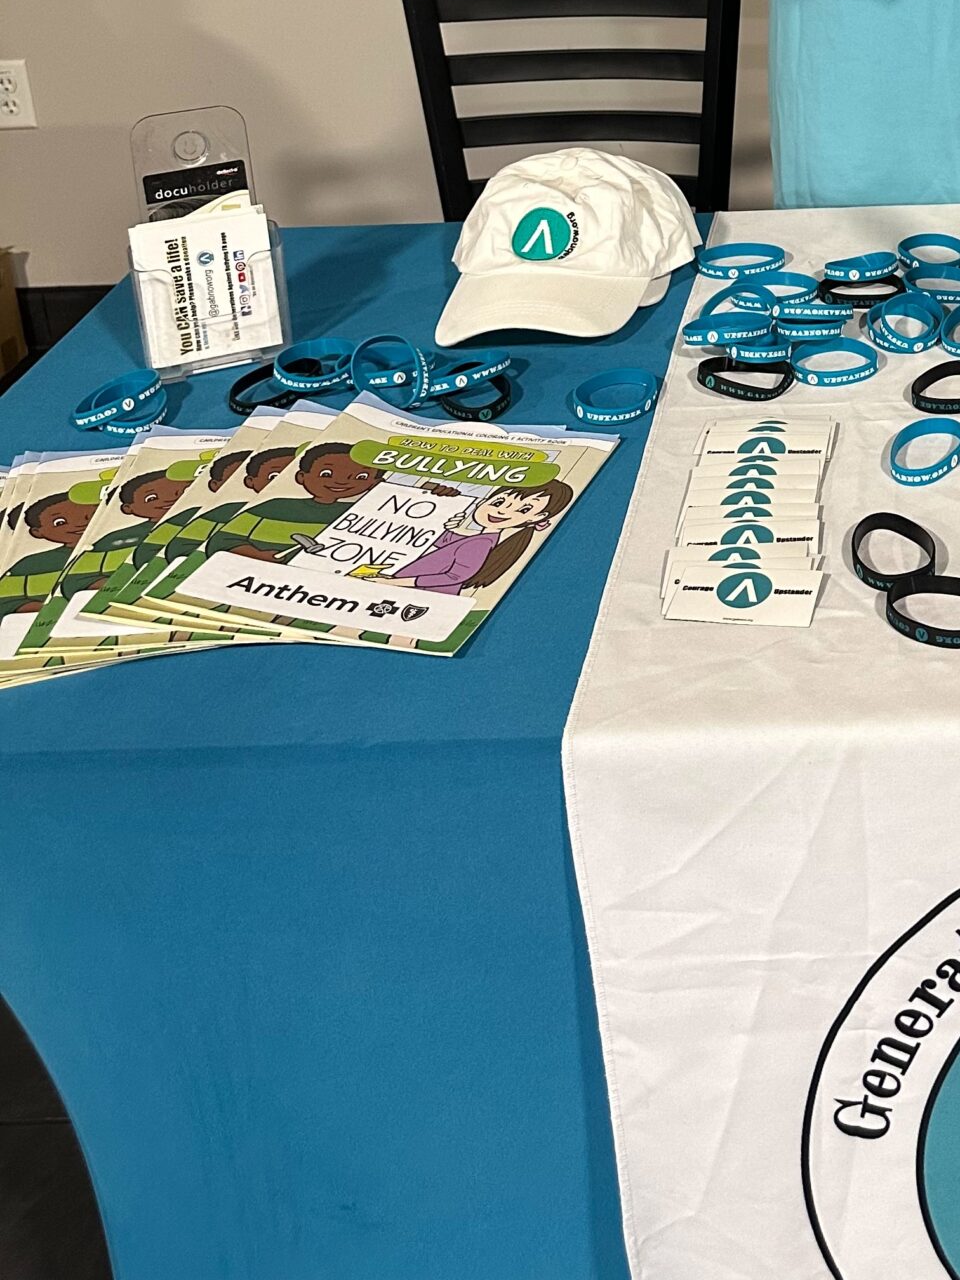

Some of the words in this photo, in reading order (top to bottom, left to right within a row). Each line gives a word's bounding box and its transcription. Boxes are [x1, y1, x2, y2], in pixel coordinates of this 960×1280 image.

[164, 239, 181, 263] life!
[180, 236, 190, 262] donation
[222, 252, 232, 272] Bullying
[184, 266, 193, 282] make
[225, 272, 233, 291] Against
[172, 276, 187, 304] save
[187, 282, 196, 301] Please
[189, 302, 198, 317] help?
[180, 332, 194, 355] You
[824, 368, 874, 383] UPSTANDER
[586, 408, 642, 422] UPSTANDER
[394, 420, 430, 432] CHILDREN'S
[431, 428, 473, 438] EDUCATIONAL
[476, 432, 509, 440] COLORING
[515, 436, 546, 444] ACTIVITY
[400, 438, 437, 450] HOW
[440, 442, 460, 453] TO
[462, 446, 496, 457] DEAL
[499, 449, 536, 460] WITH
[372, 450, 530, 483] BULLYING
[378, 494, 437, 519] NO
[332, 512, 436, 547] BULLYING
[226, 576, 360, 613] Anthem
